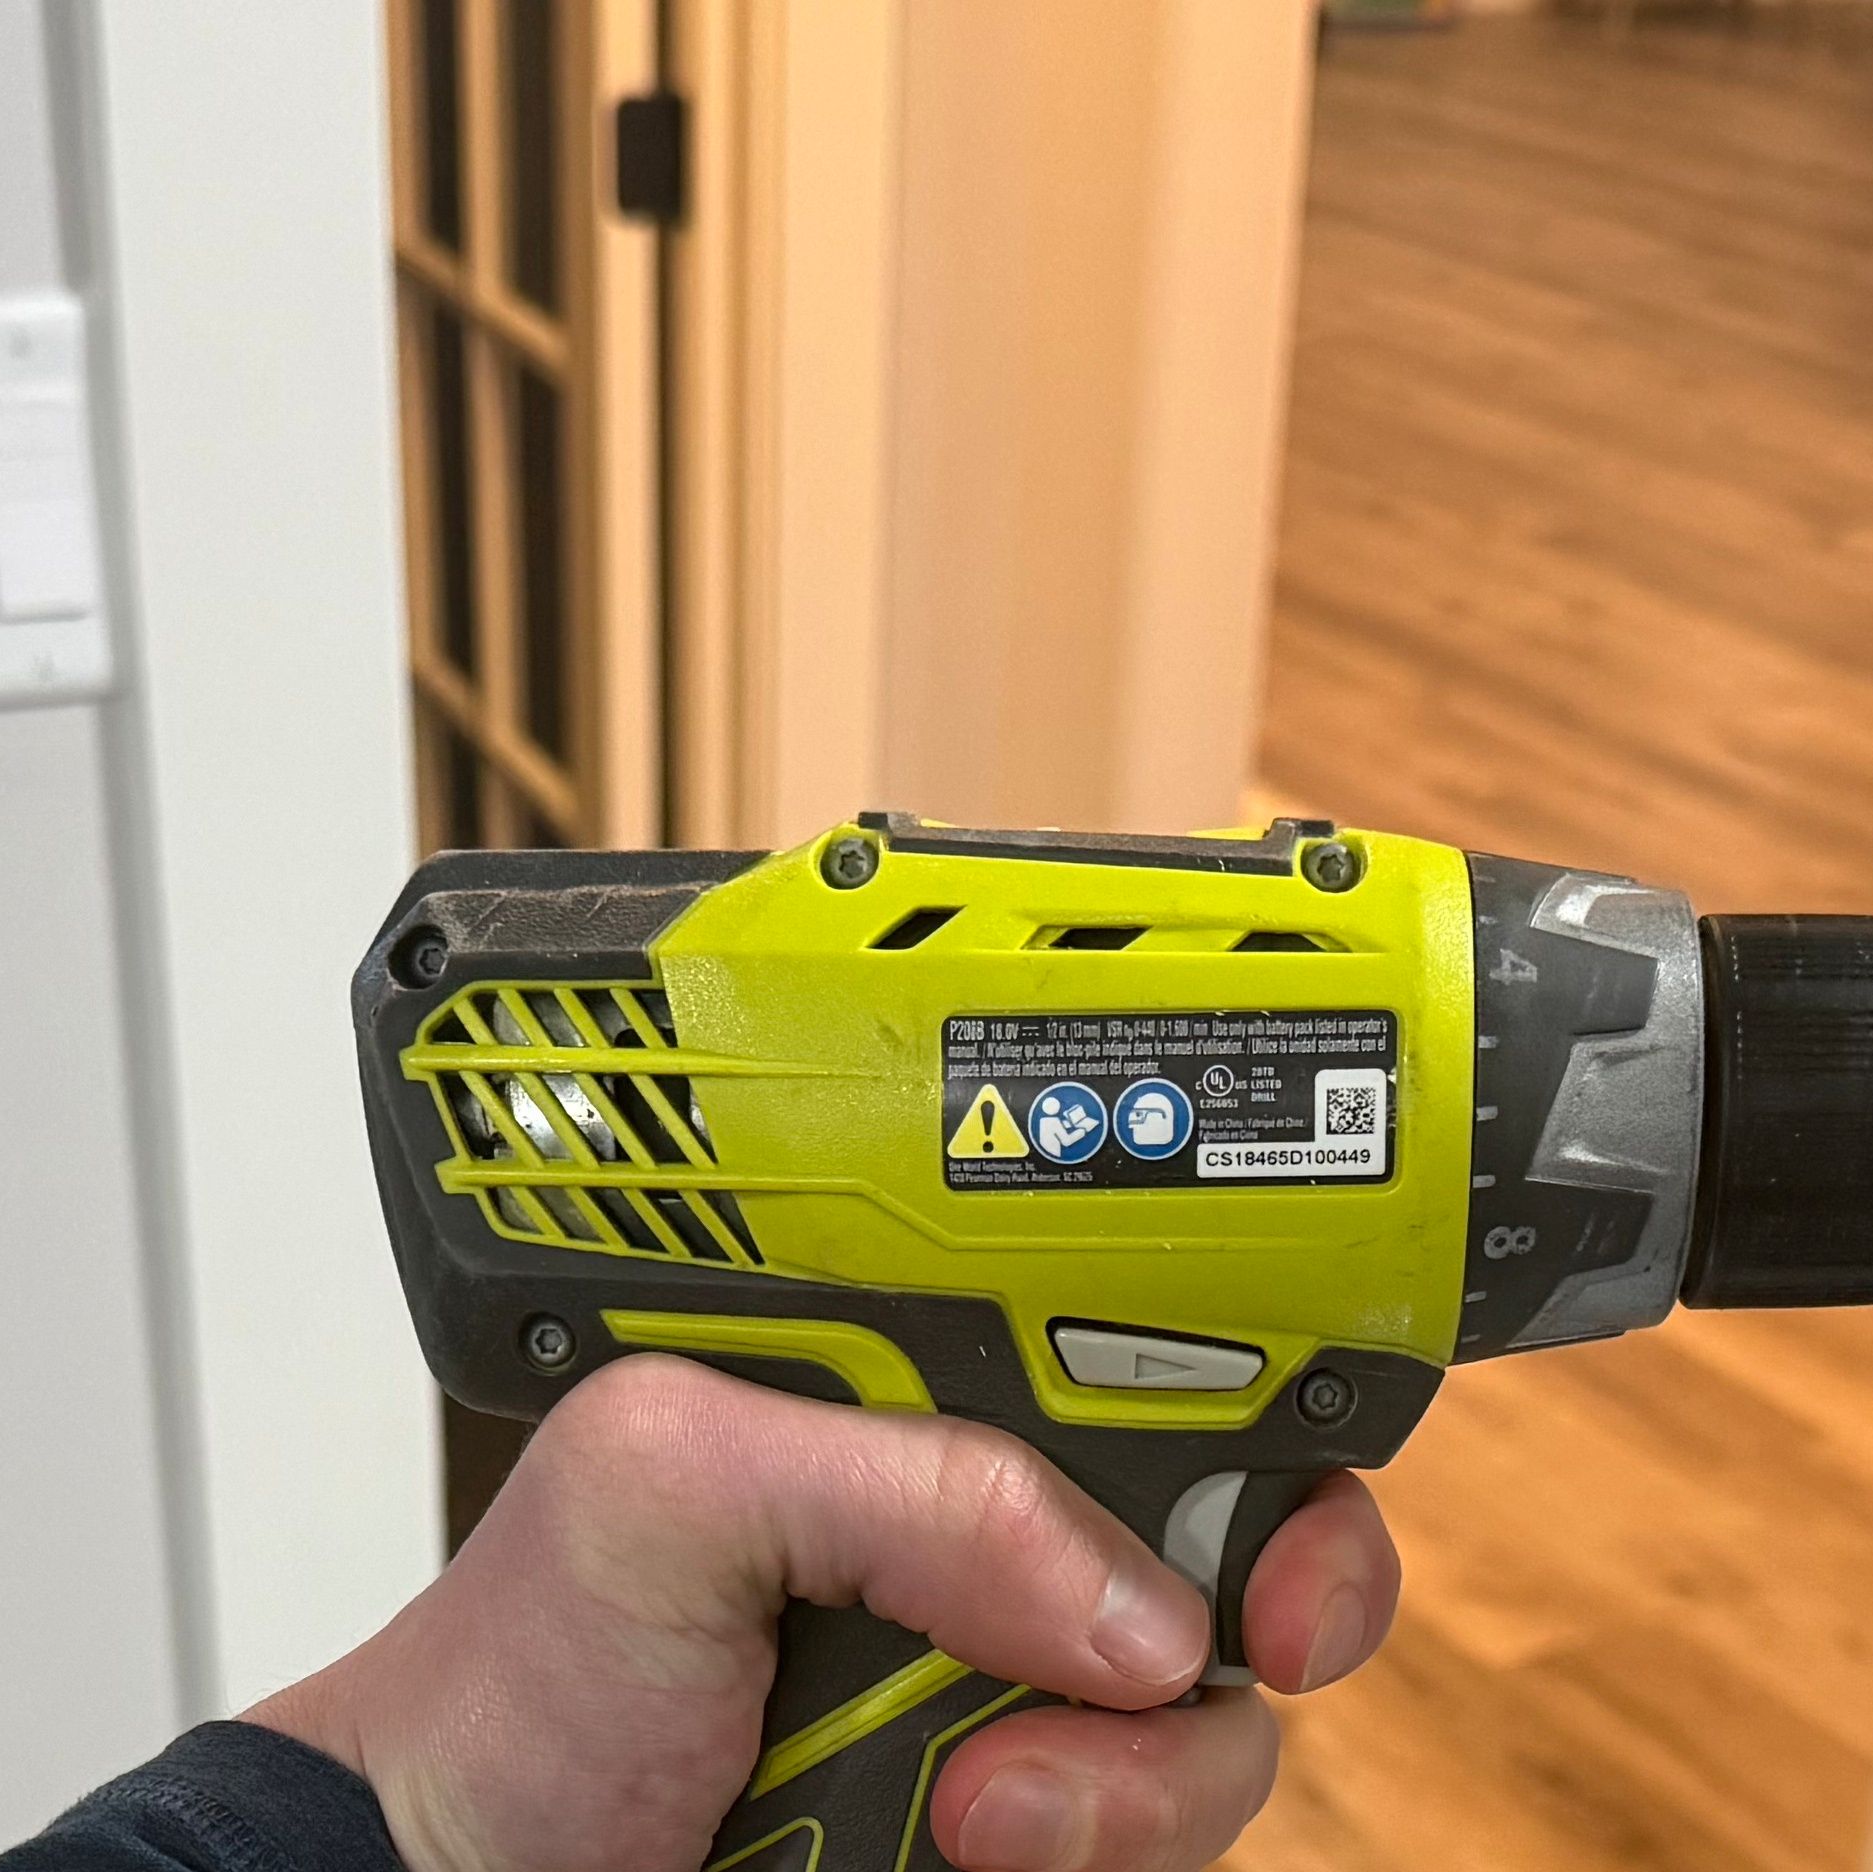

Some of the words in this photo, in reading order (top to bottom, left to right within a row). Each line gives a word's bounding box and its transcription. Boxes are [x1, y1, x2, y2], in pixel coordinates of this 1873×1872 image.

[1489, 947, 1538, 986] 4
[991, 1022, 1019, 1041] 18.0V
[1212, 1020, 1228, 1036] Use
[1229, 1019, 1247, 1039] only
[1247, 1019, 1265, 1036] with
[1266, 1018, 1294, 1039] battery
[1294, 1018, 1314, 1038] pack
[1315, 1017, 1337, 1035] listed
[1338, 1017, 1347, 1034] in
[1056, 1041, 1064, 1058] le
[1133, 1040, 1153, 1056] dans
[1154, 1039, 1163, 1056] le
[1163, 1039, 1194, 1056] manuel
[1318, 1036, 1360, 1053] solamente
[1361, 1038, 1376, 1052] con
[1378, 1035, 1387, 1052] el
[981, 1061, 992, 1077] de
[1022, 1060, 1056, 1077] indicado
[1057, 1063, 1067, 1076] en
[1069, 1060, 1077, 1076] el
[1078, 1059, 1108, 1076] manual
[1251, 1079, 1282, 1090] LISTED
[1206, 1149, 1371, 1167] CS18465D100449
[1484, 1226, 1537, 1260] 8
